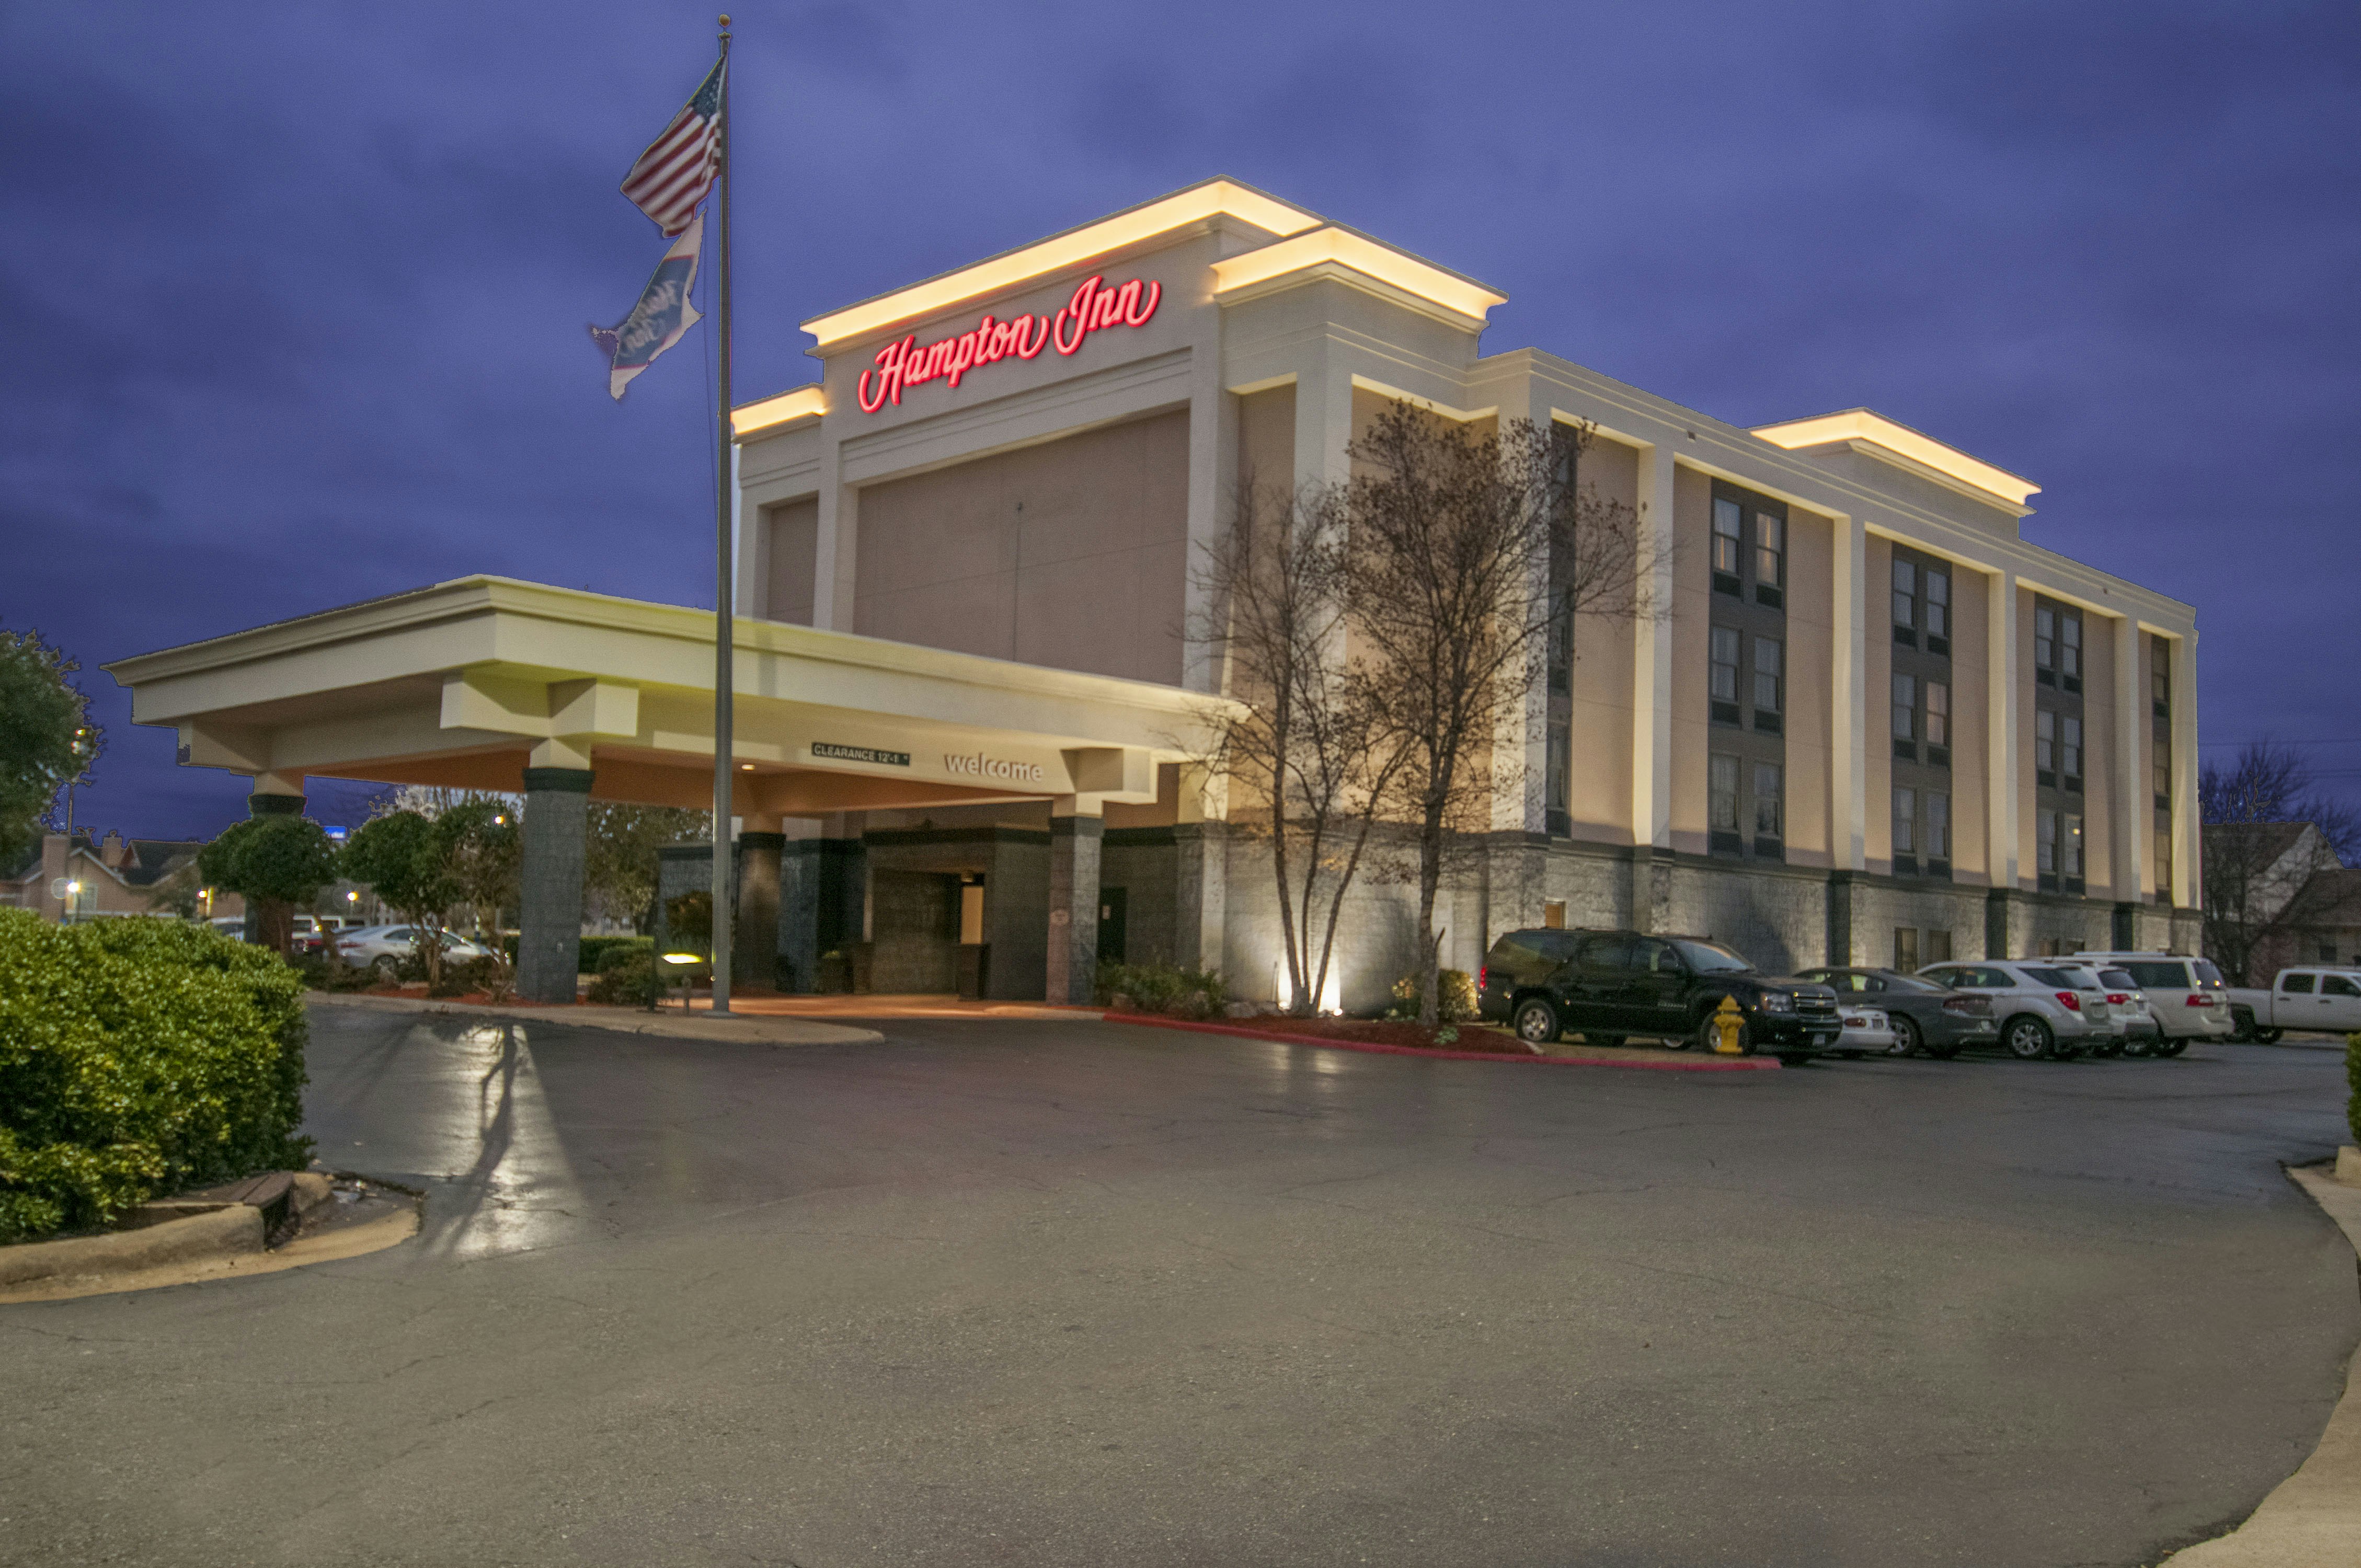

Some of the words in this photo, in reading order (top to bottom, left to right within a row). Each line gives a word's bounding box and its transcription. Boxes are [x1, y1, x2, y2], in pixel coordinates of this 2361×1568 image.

[858, 314, 1049, 413] Hampton
[1053, 275, 1160, 355] Inn
[814, 744, 875, 761] CLEARANCE
[944, 753, 1044, 782] welcome
